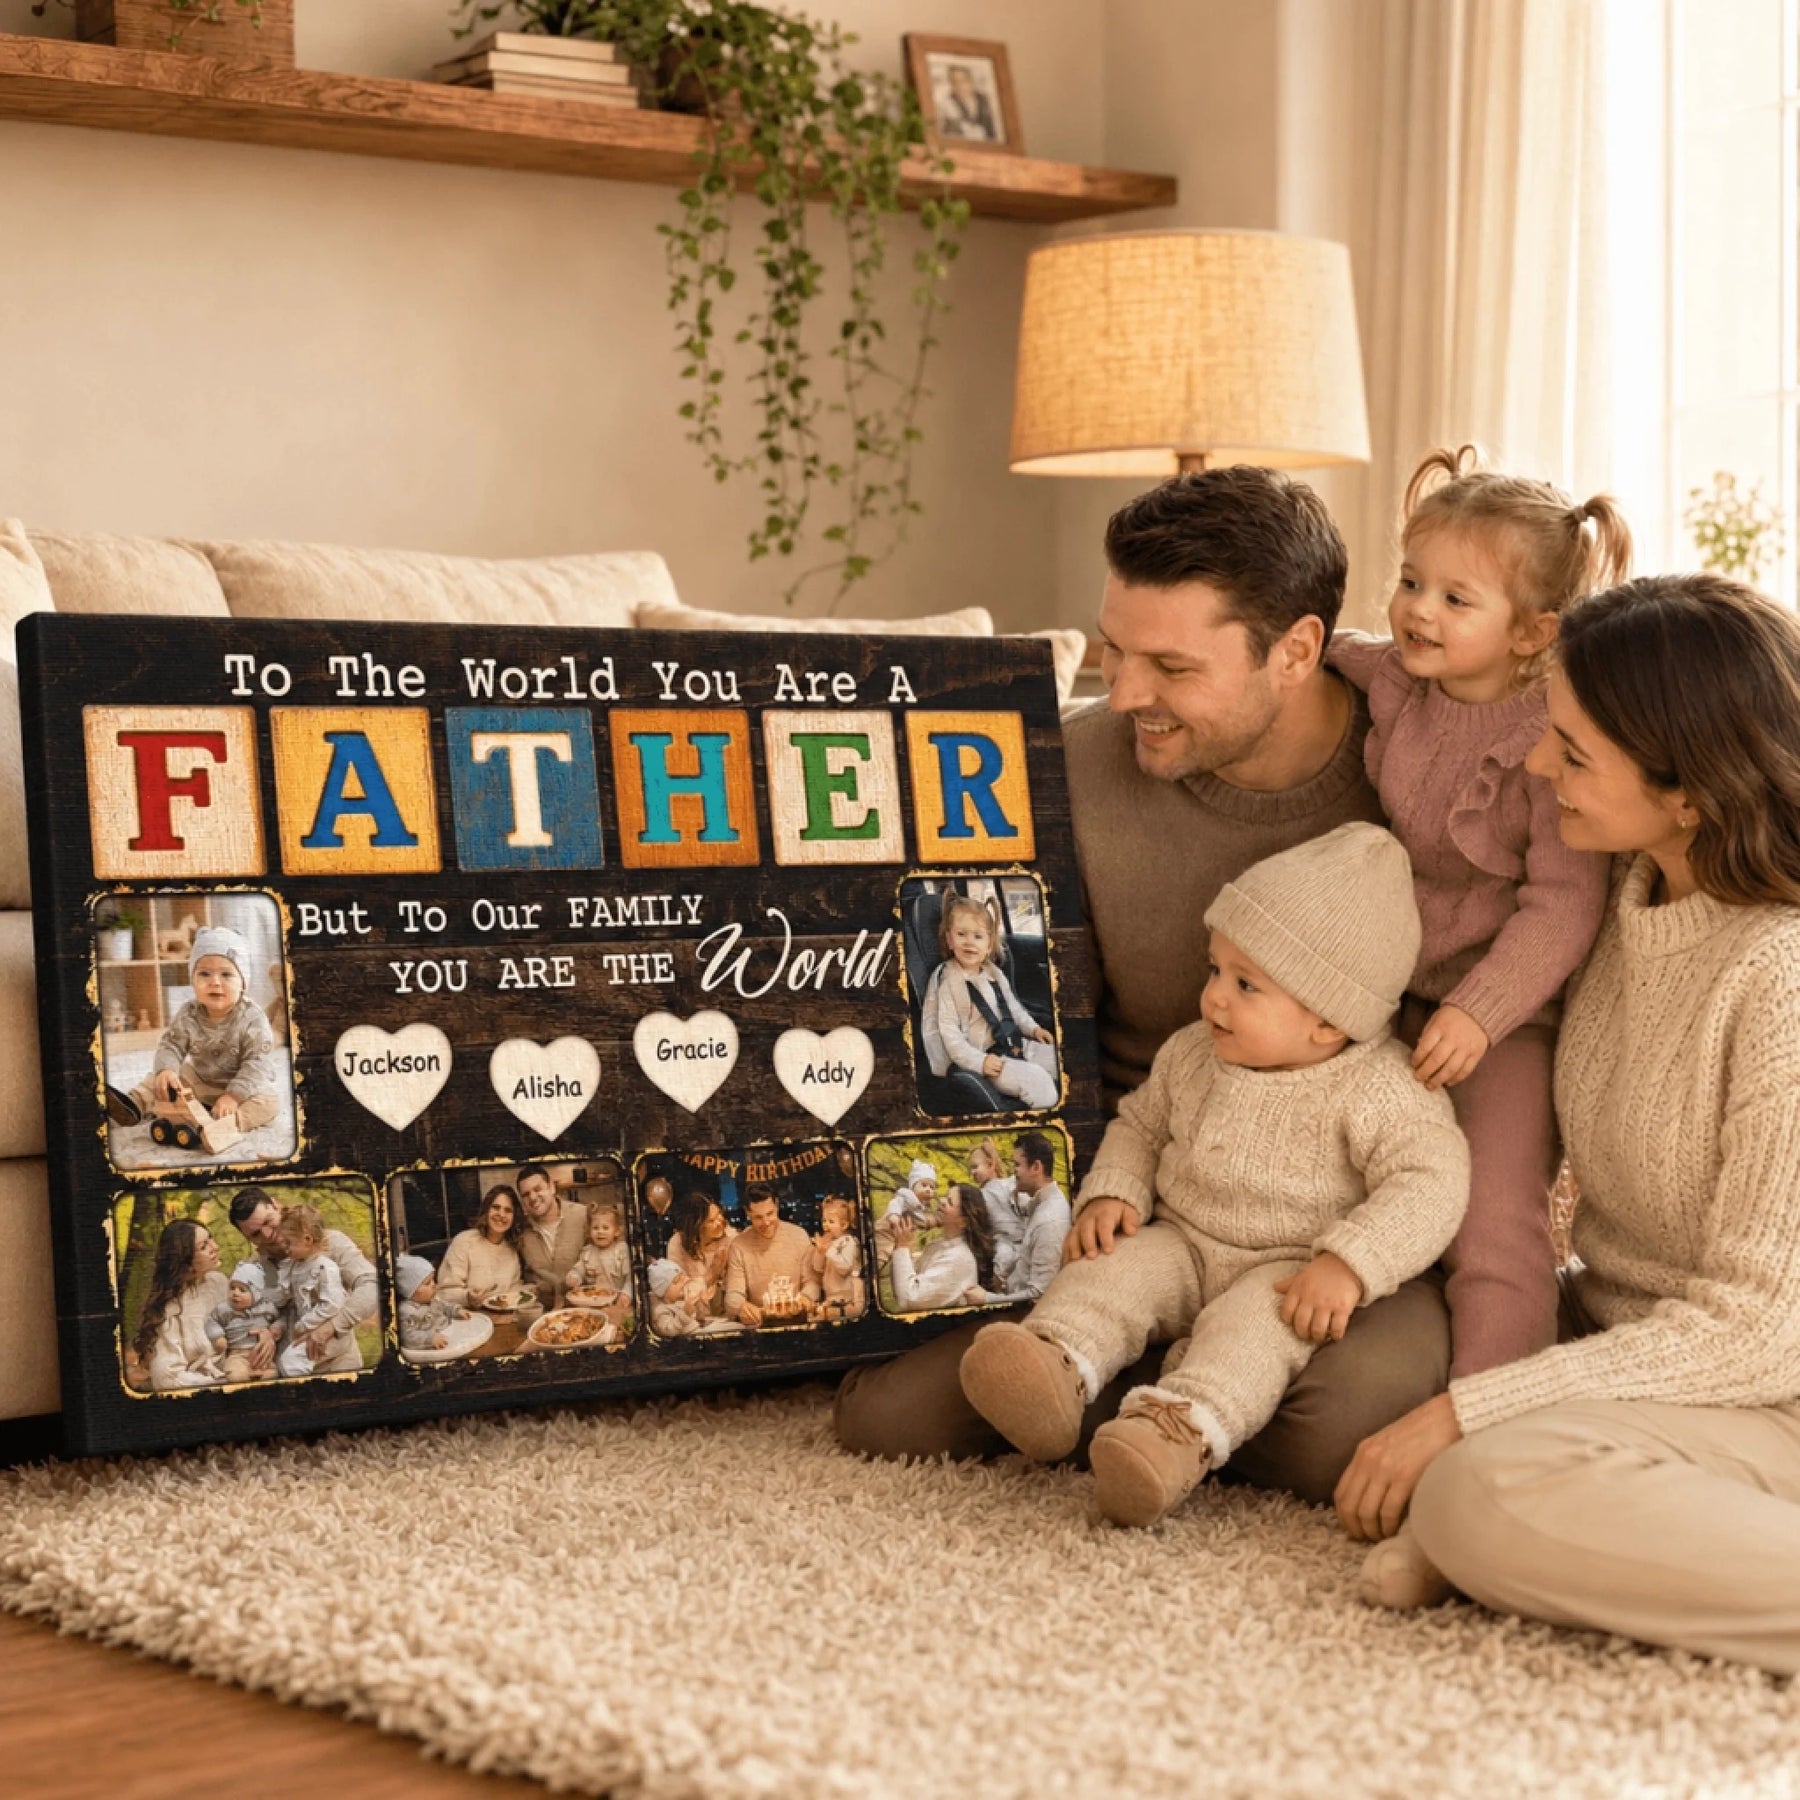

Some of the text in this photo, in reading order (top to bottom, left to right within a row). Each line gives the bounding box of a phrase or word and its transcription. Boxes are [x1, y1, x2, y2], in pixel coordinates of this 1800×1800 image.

[224, 652, 918, 703] To The World You Are A
[116, 730, 1019, 852] FATHER
[297, 894, 704, 936] But To Our FAMILY
[389, 907, 894, 999] YOU ARE THE World
[342, 1050, 441, 1077] Jackson
[656, 1037, 728, 1062] Gracie
[512, 1074, 583, 1100] Alisha
[802, 1061, 855, 1088] Addy
